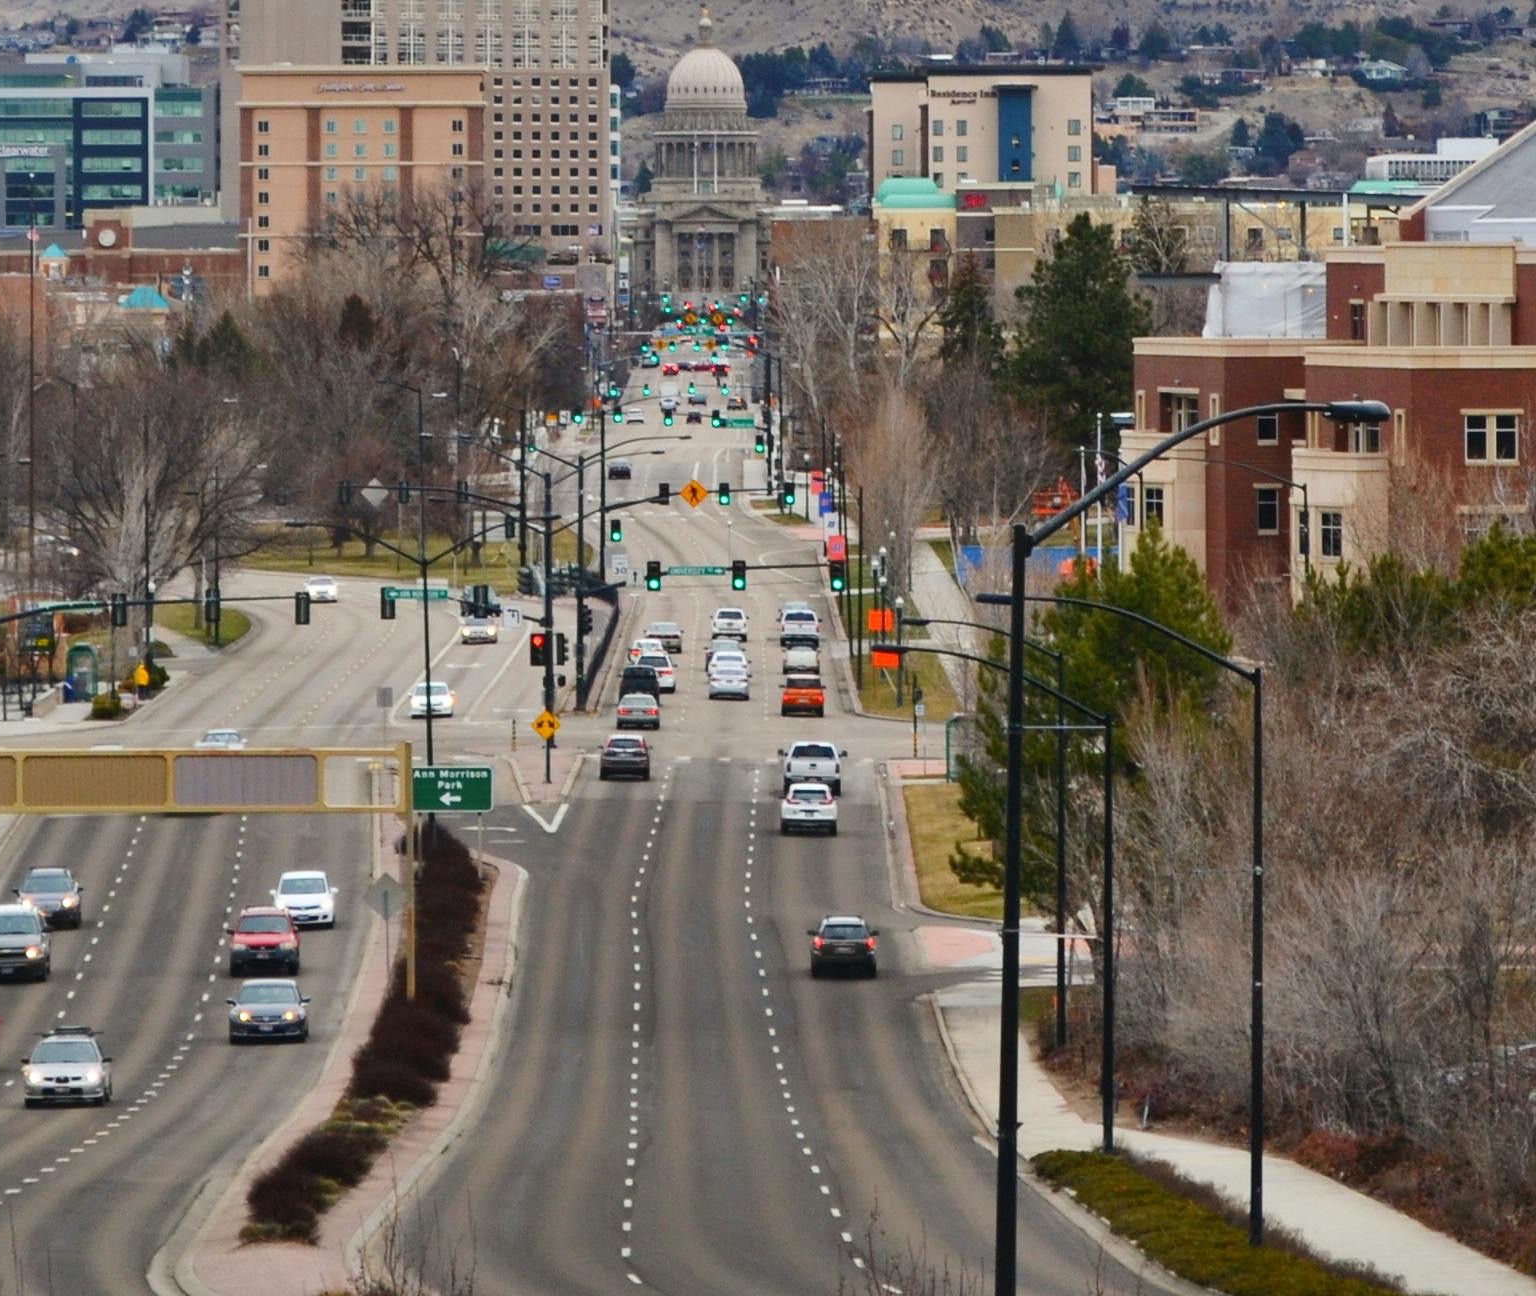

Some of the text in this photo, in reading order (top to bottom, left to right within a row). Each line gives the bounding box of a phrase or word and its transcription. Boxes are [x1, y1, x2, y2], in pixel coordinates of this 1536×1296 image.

[930, 89, 997, 98] Residence Inn
[413, 770, 488, 779] Ann Morrison
[437, 780, 463, 790] Park
